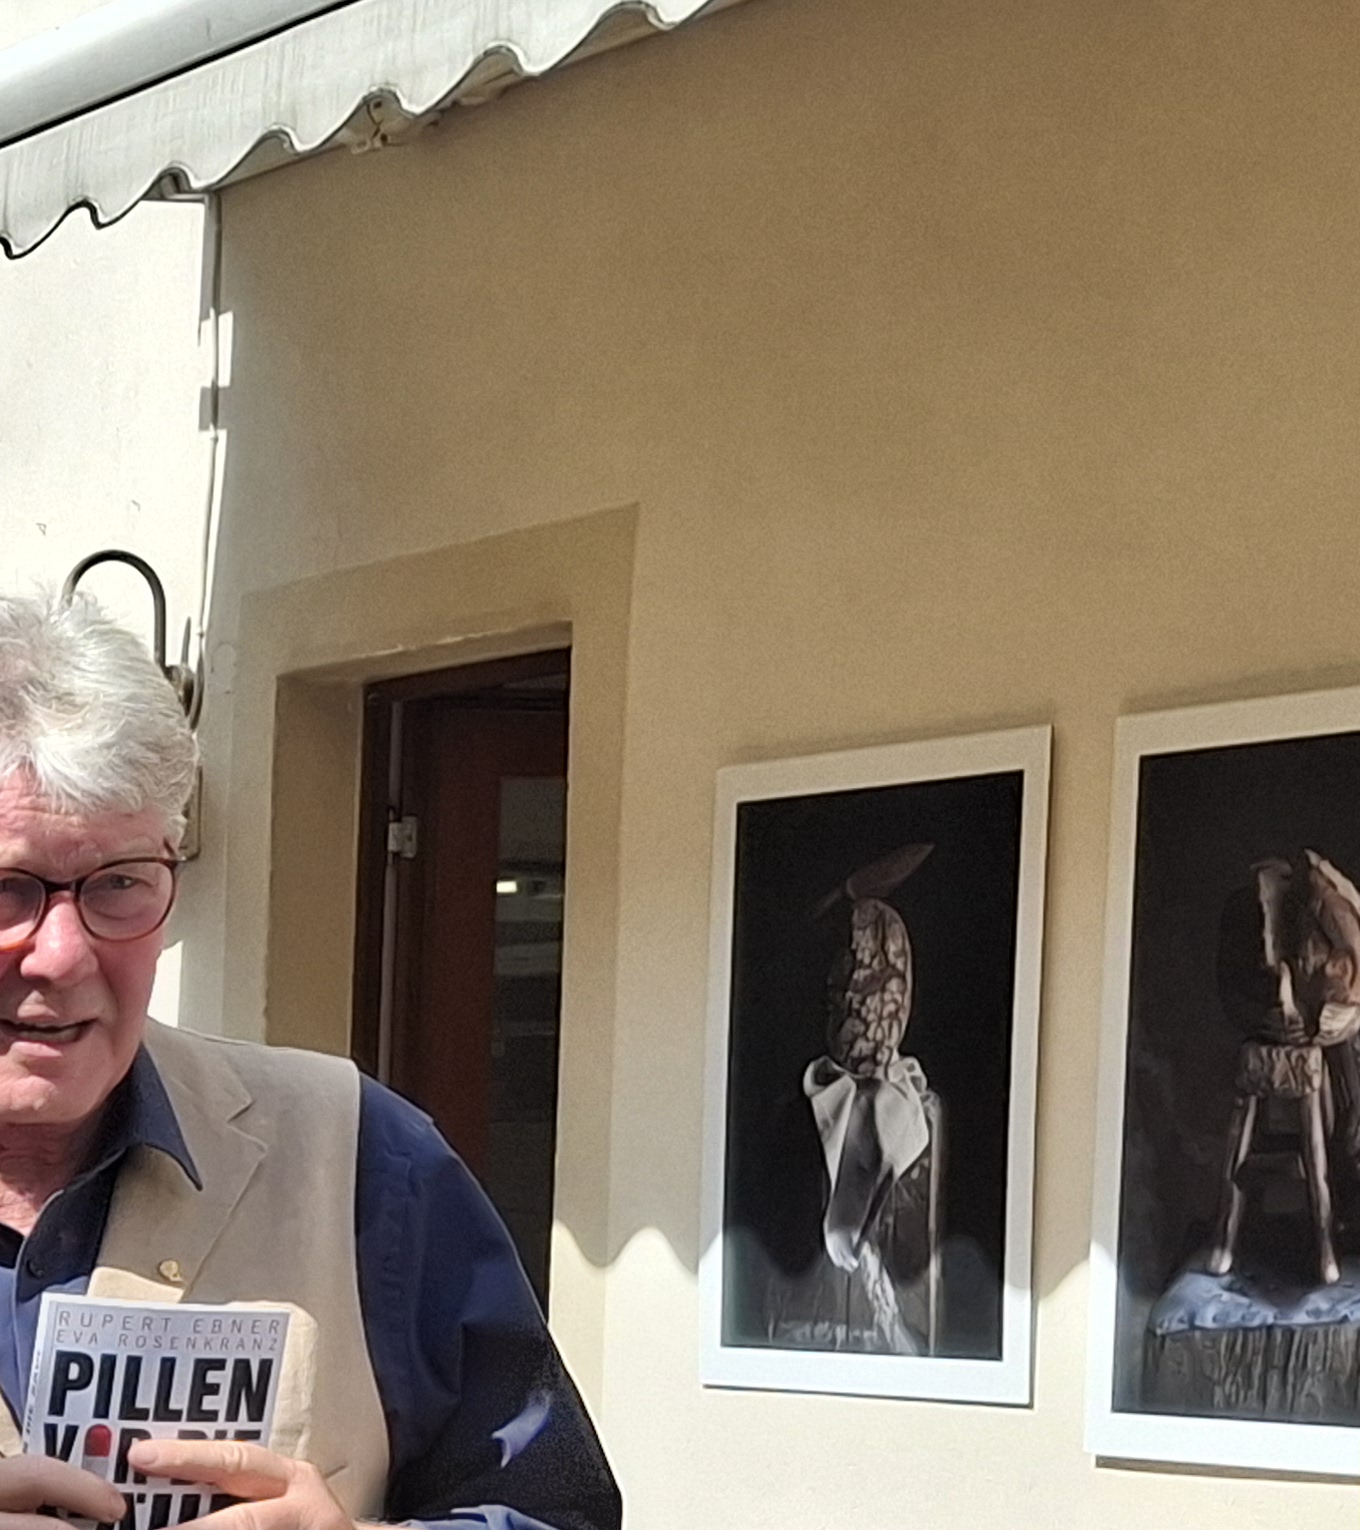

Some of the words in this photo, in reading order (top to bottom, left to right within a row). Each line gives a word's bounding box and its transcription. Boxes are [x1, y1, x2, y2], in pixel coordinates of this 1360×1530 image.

[58, 1310, 171, 1332] RUPERT
[192, 1318, 280, 1335] EBNER
[56, 1328, 99, 1345] EVA
[118, 1333, 278, 1351] ROSENKRANZ
[47, 1350, 274, 1422] PILLEN
